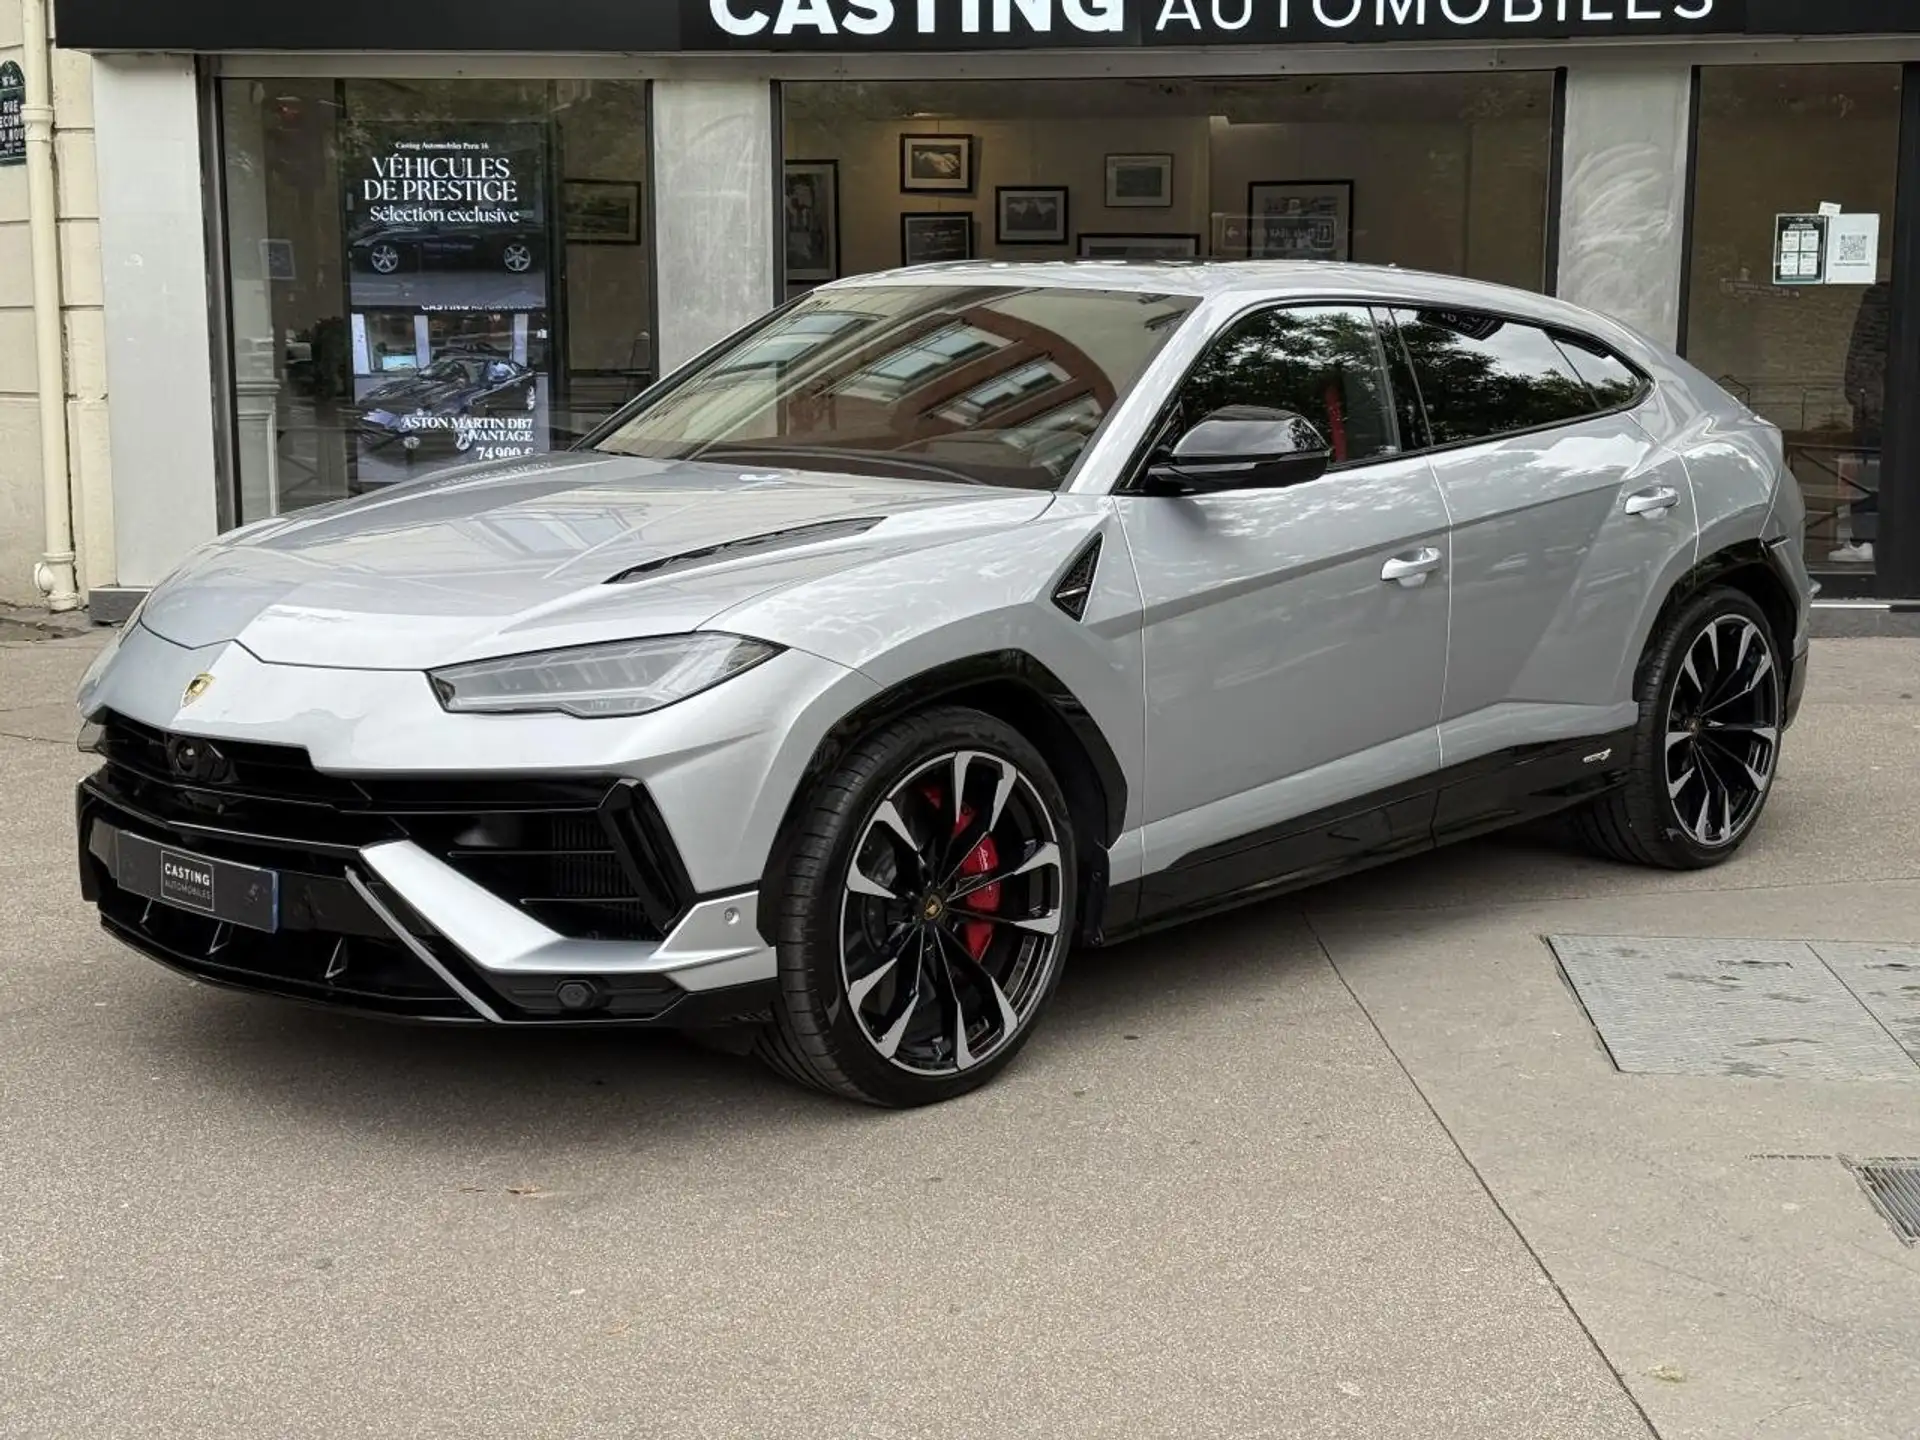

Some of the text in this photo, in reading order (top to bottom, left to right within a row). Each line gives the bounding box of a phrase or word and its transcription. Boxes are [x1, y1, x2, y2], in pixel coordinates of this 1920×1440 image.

[710, 0, 1124, 35] CASTING
[372, 153, 510, 179] VÉHICULES
[364, 180, 518, 202] DE PRESTIGE
[370, 205, 519, 223] Sélection exclusive
[402, 417, 533, 429] ASTON MARTIN DB7
[469, 430, 534, 442] VANTAGE
[165, 862, 210, 886] CASTING
